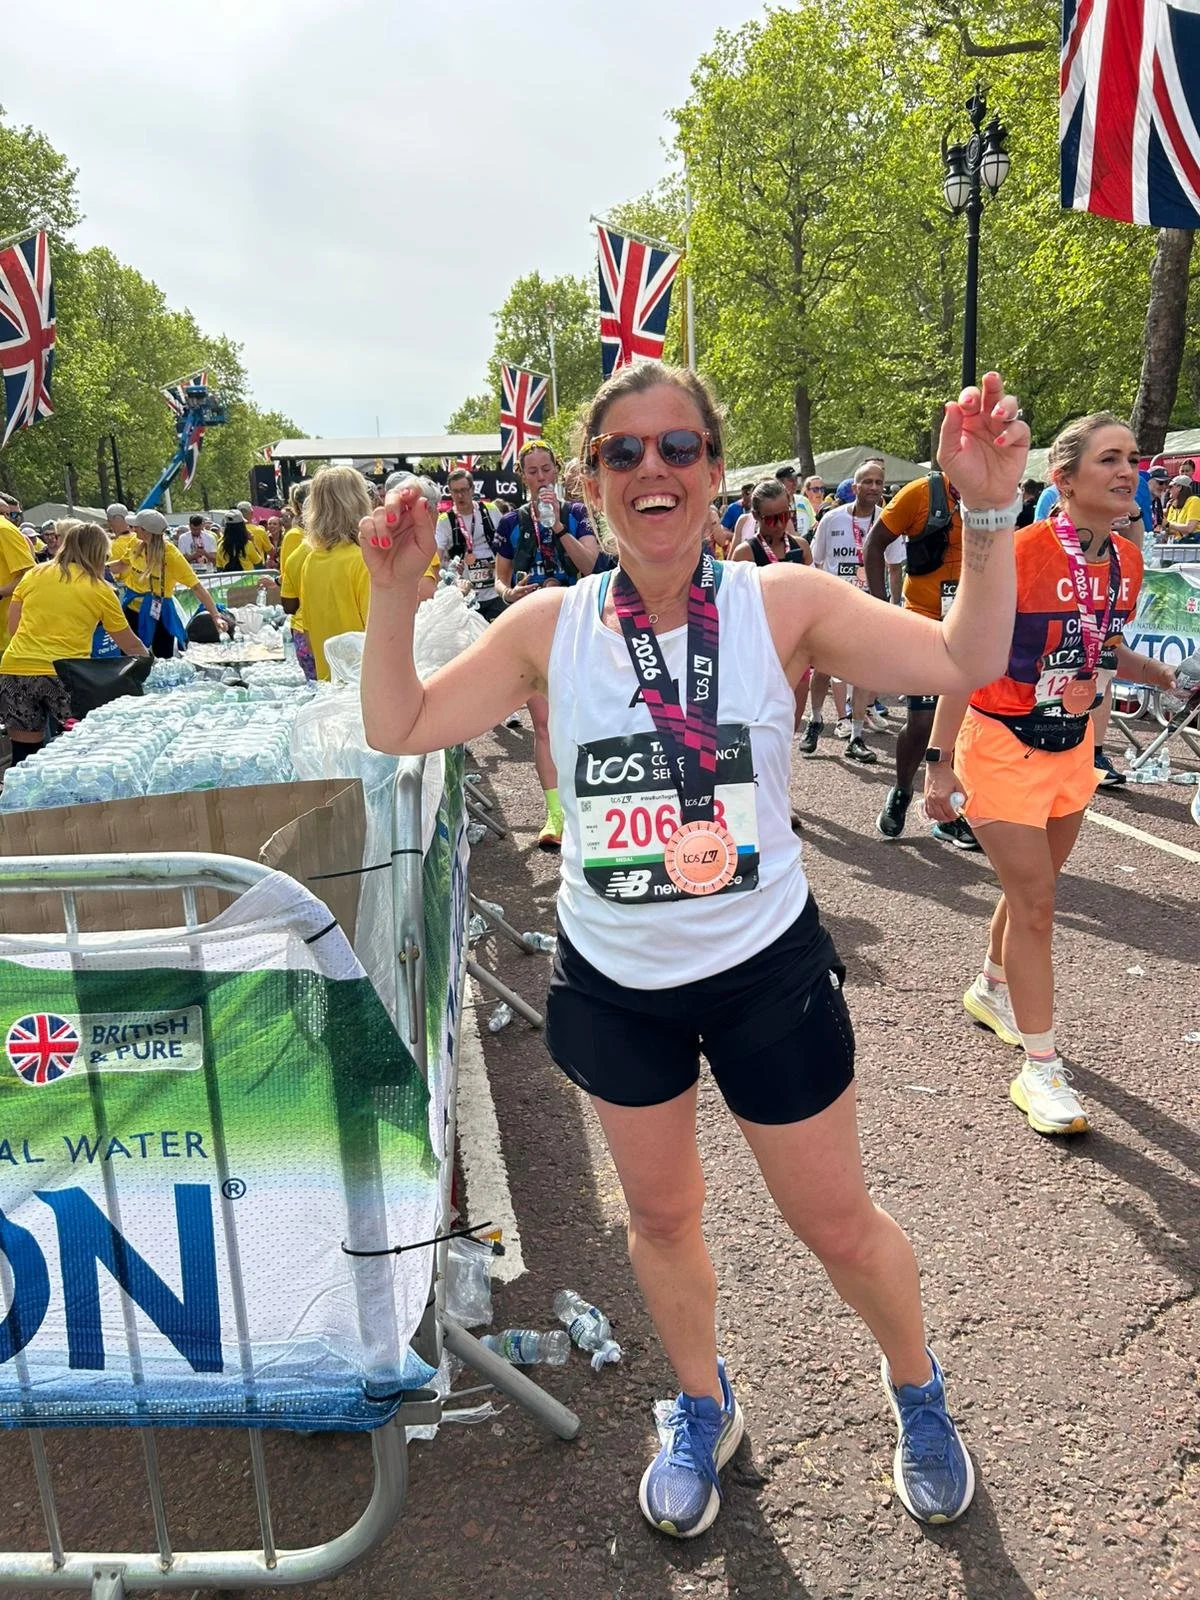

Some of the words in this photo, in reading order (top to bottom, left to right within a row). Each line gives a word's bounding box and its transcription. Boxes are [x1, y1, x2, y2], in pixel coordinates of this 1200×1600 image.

[495, 479, 518, 494] tcs
[840, 566, 854, 575] tcs
[1056, 577, 1131, 602] CLE
[1074, 568, 1088, 600] 2026
[631, 633, 662, 681] 2026
[693, 677, 710, 701] tcs
[586, 752, 645, 785] tcs
[685, 798, 698, 807] tcs
[604, 799, 728, 849] 206
[683, 853, 700, 864] tcs
[90, 1016, 189, 1045] BRITISH
[89, 1049, 108, 1064] &
[116, 1040, 184, 1061] PURE
[63, 1130, 208, 1164] WATER
